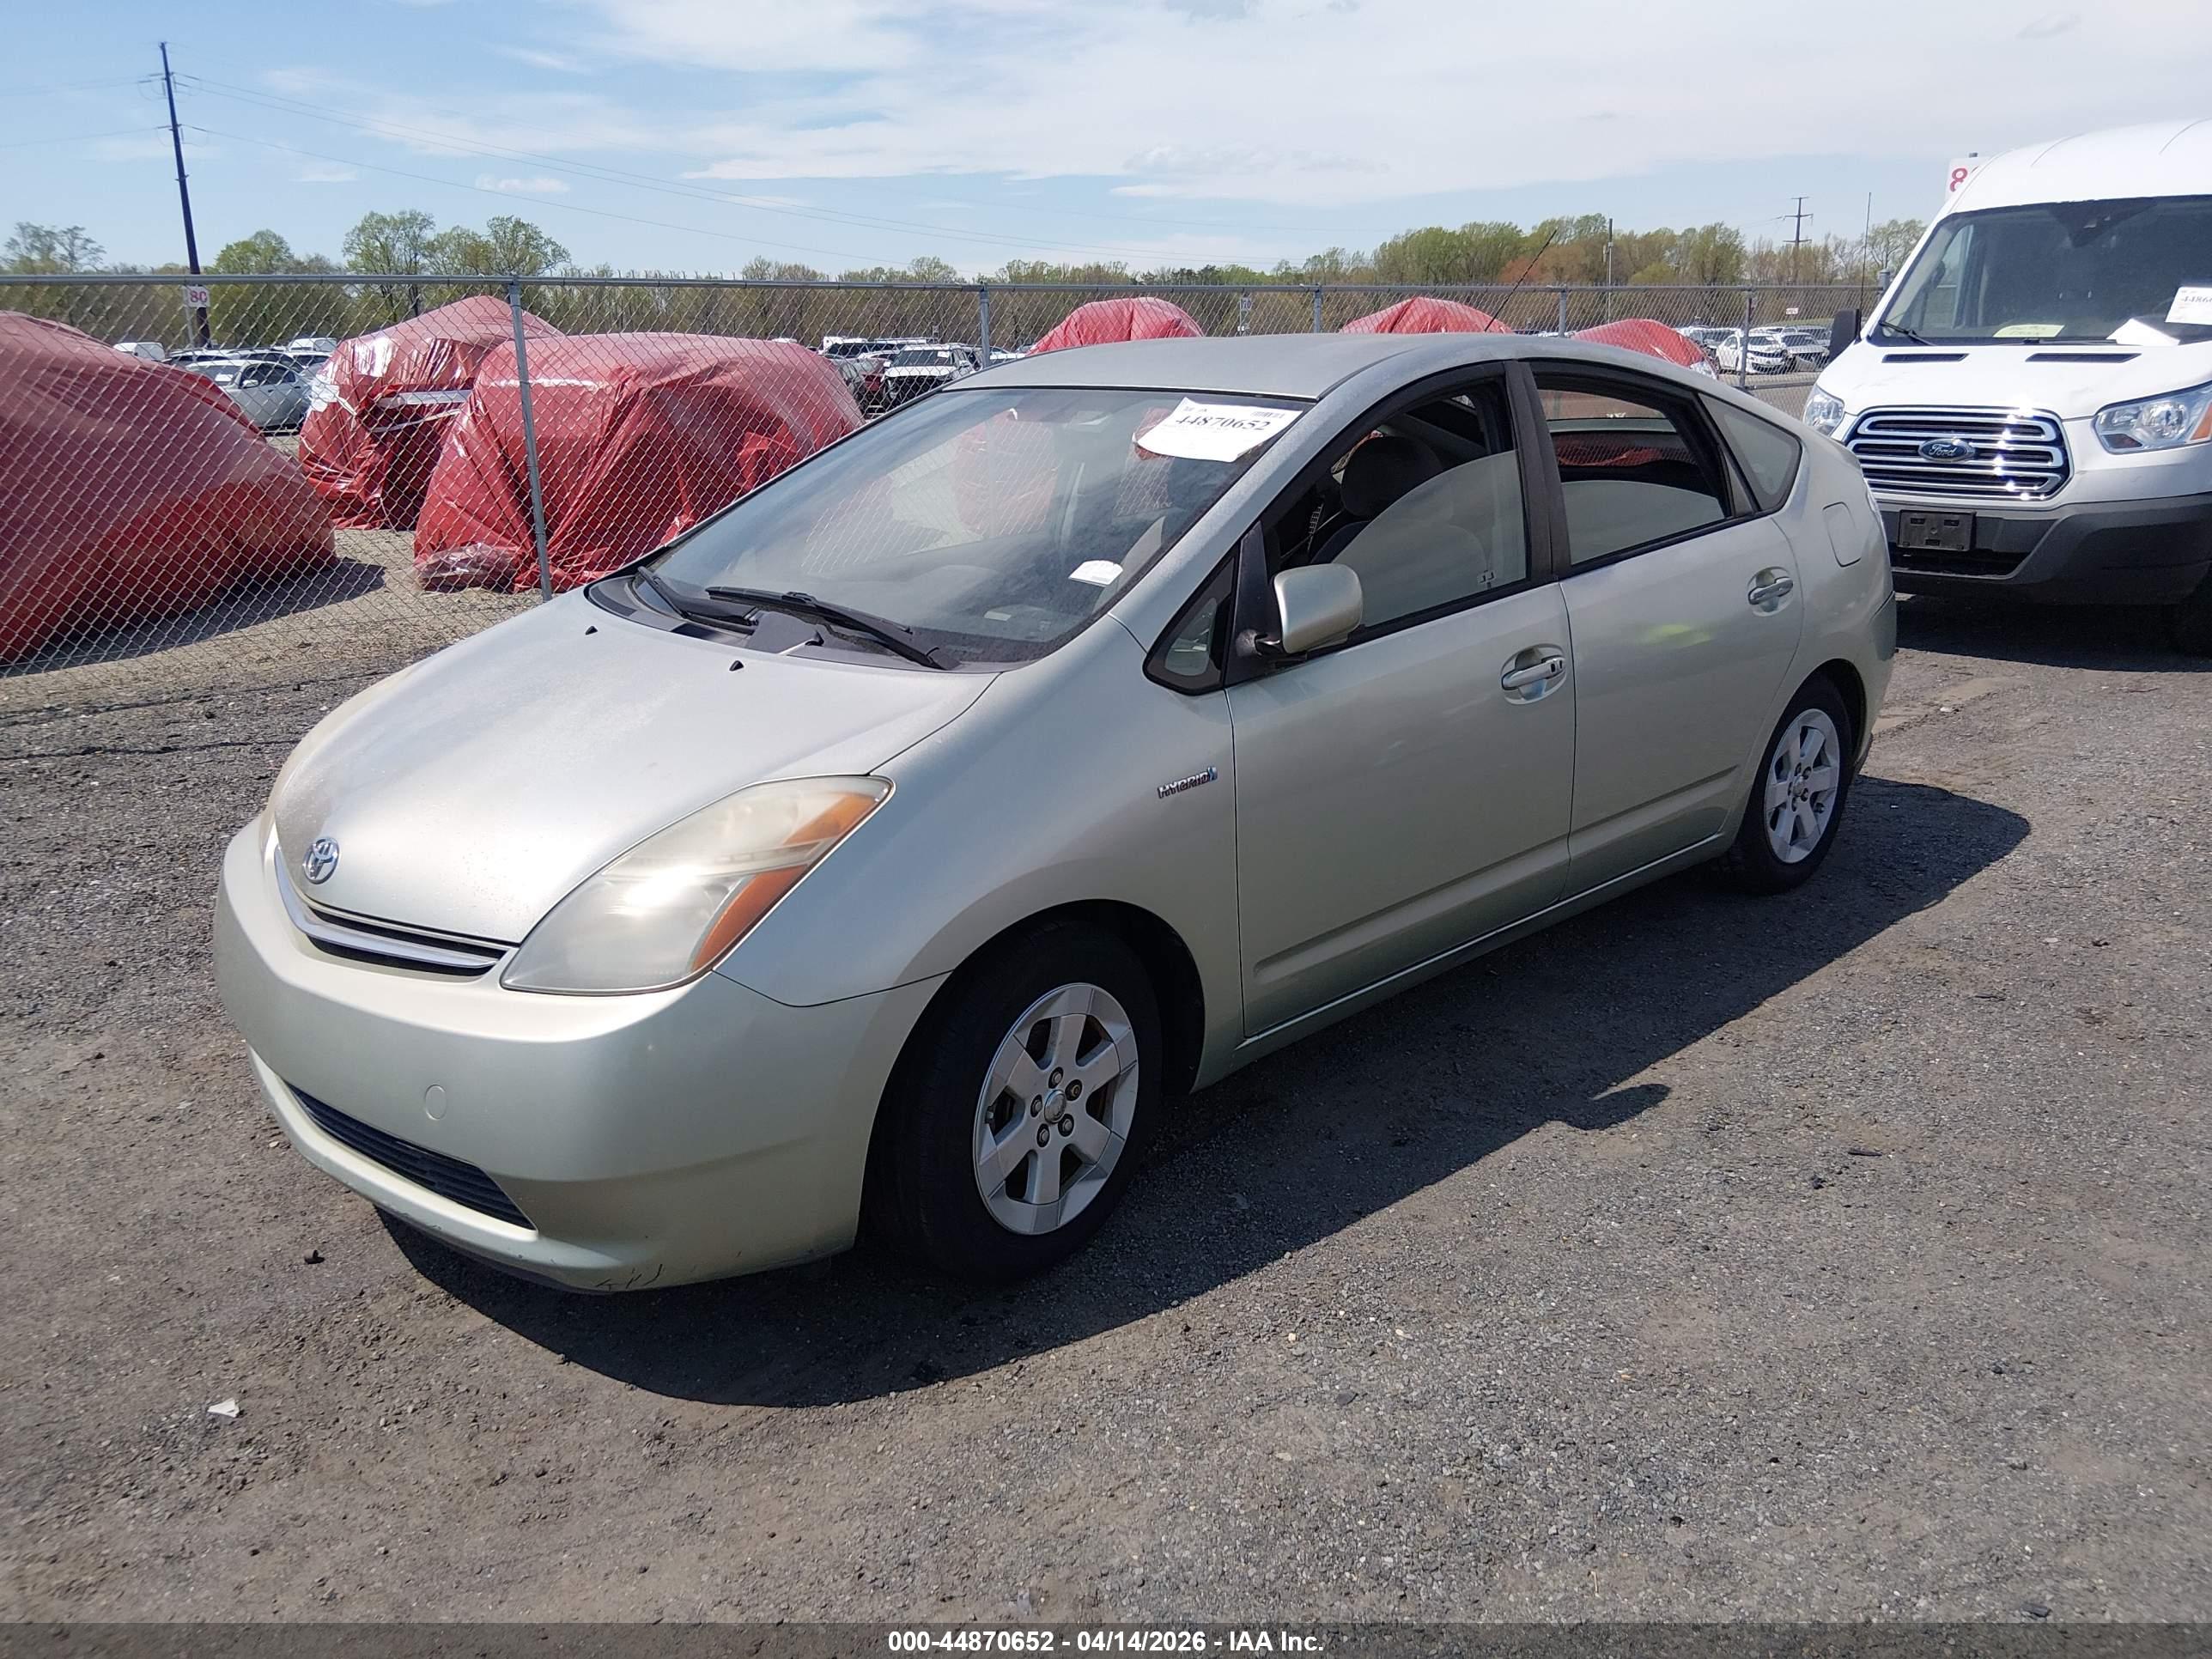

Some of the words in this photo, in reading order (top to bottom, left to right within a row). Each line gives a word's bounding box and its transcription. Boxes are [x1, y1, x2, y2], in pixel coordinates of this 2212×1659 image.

[1176, 415, 1272, 431] 44870652
[1929, 443, 1958, 457] Ford
[1157, 771, 1210, 799] HYBRID
